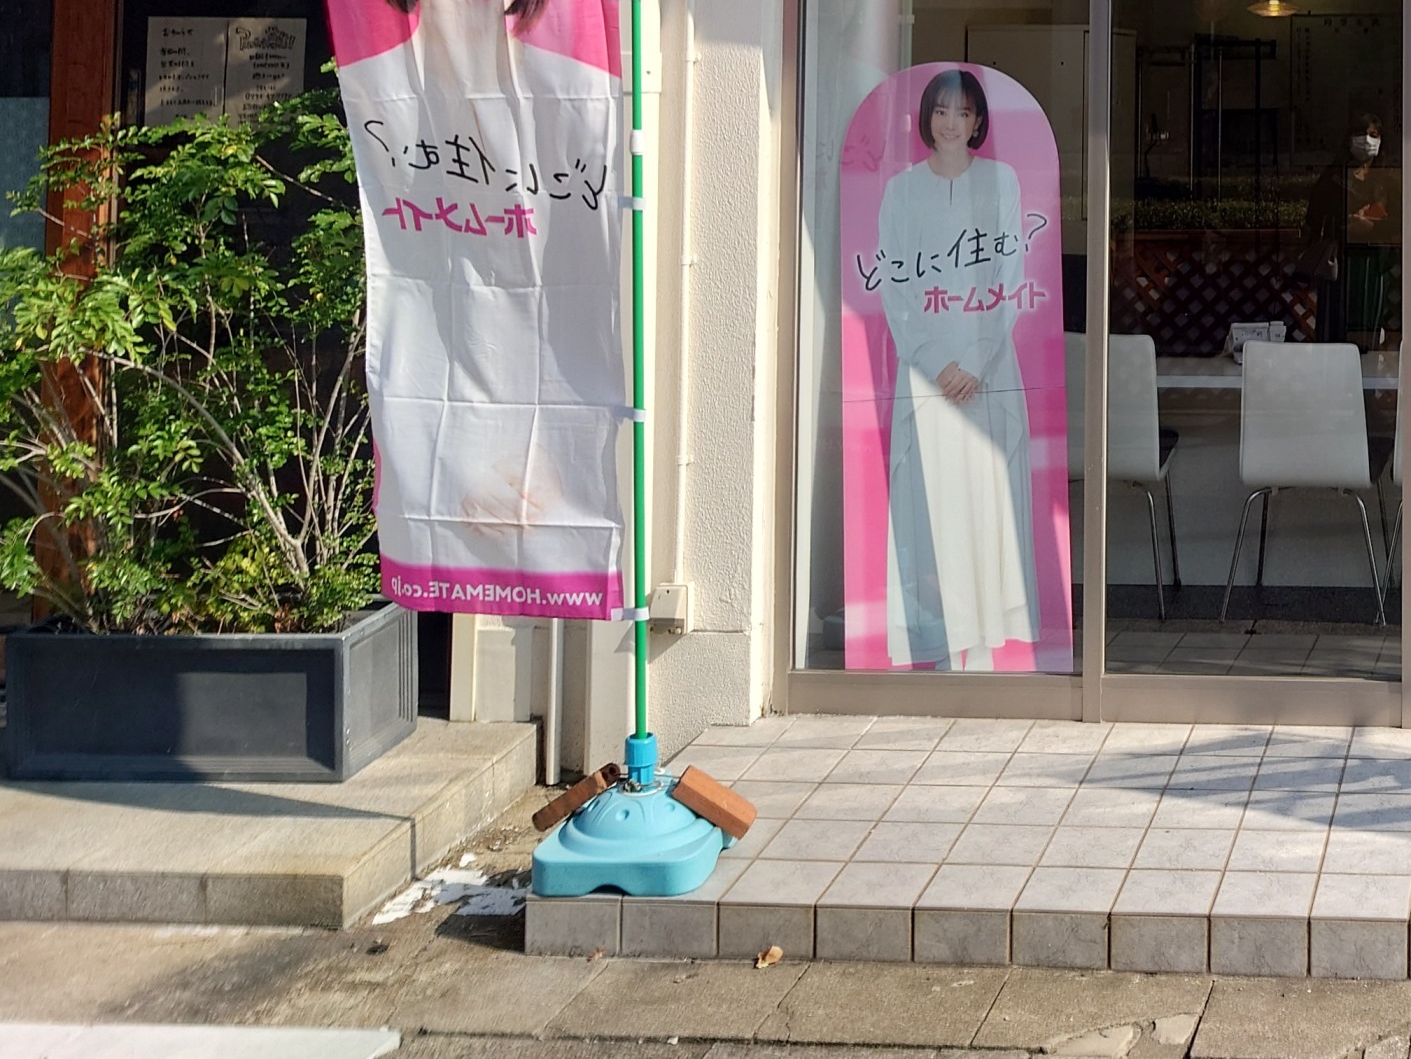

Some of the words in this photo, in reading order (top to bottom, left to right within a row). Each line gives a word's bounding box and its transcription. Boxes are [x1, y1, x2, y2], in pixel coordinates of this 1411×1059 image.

[924, 282, 1047, 314] ホームメイト
